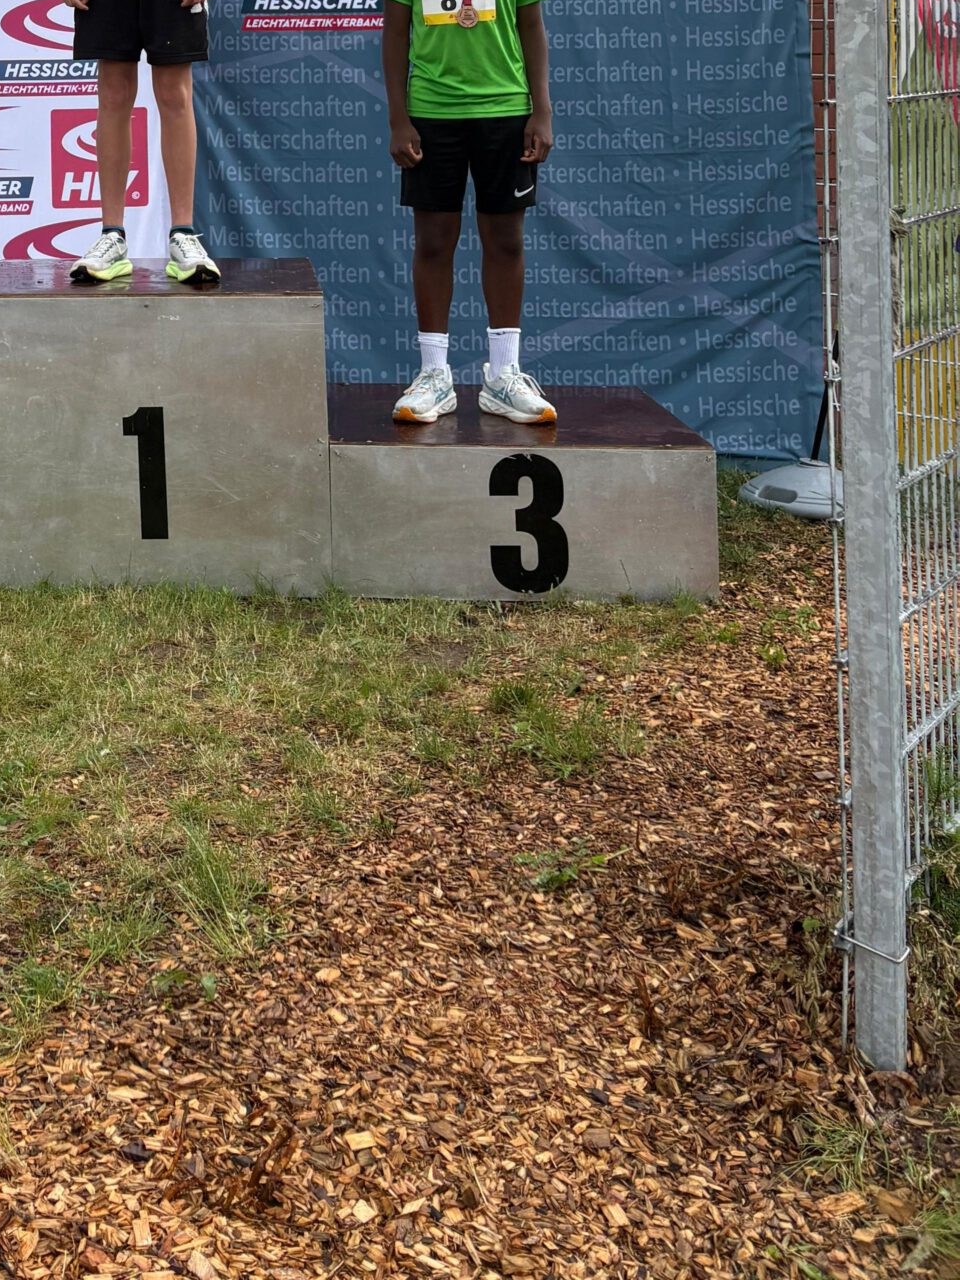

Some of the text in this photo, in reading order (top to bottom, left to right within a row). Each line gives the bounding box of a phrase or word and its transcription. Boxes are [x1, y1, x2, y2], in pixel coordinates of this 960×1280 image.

[547, 26, 662, 49] terschaften
[686, 23, 785, 47] Hessische
[4, 62, 99, 78] HESSISCH
[205, 62, 366, 84] Meisterschaften
[686, 57, 786, 80] Hessische
[205, 90, 788, 117] Meisterschaften erschaften Hessische
[206, 124, 790, 150] Meisterschaften erschaften Hessische
[207, 160, 368, 183] Meisterschaften
[538, 160, 665, 183] sterschaften
[688, 158, 790, 182] Hessische
[208, 193, 369, 217] Meisterschaften
[690, 192, 791, 216] Hessische
[208, 225, 370, 250] Meisterschaften
[523, 228, 668, 250] eisterschaften
[691, 225, 793, 249] Hessische
[524, 259, 796, 284] eisterschaften Hessische
[522, 295, 670, 318] eisterschaften
[693, 292, 797, 316] Hessische
[522, 329, 671, 352] eisterschaften
[695, 326, 798, 350] Hessische
[527, 362, 672, 385] eisterschaften
[696, 359, 799, 384] Hessische
[698, 392, 800, 417] Hessische
[123, 407, 168, 540] 1
[489, 453, 569, 594] 3
